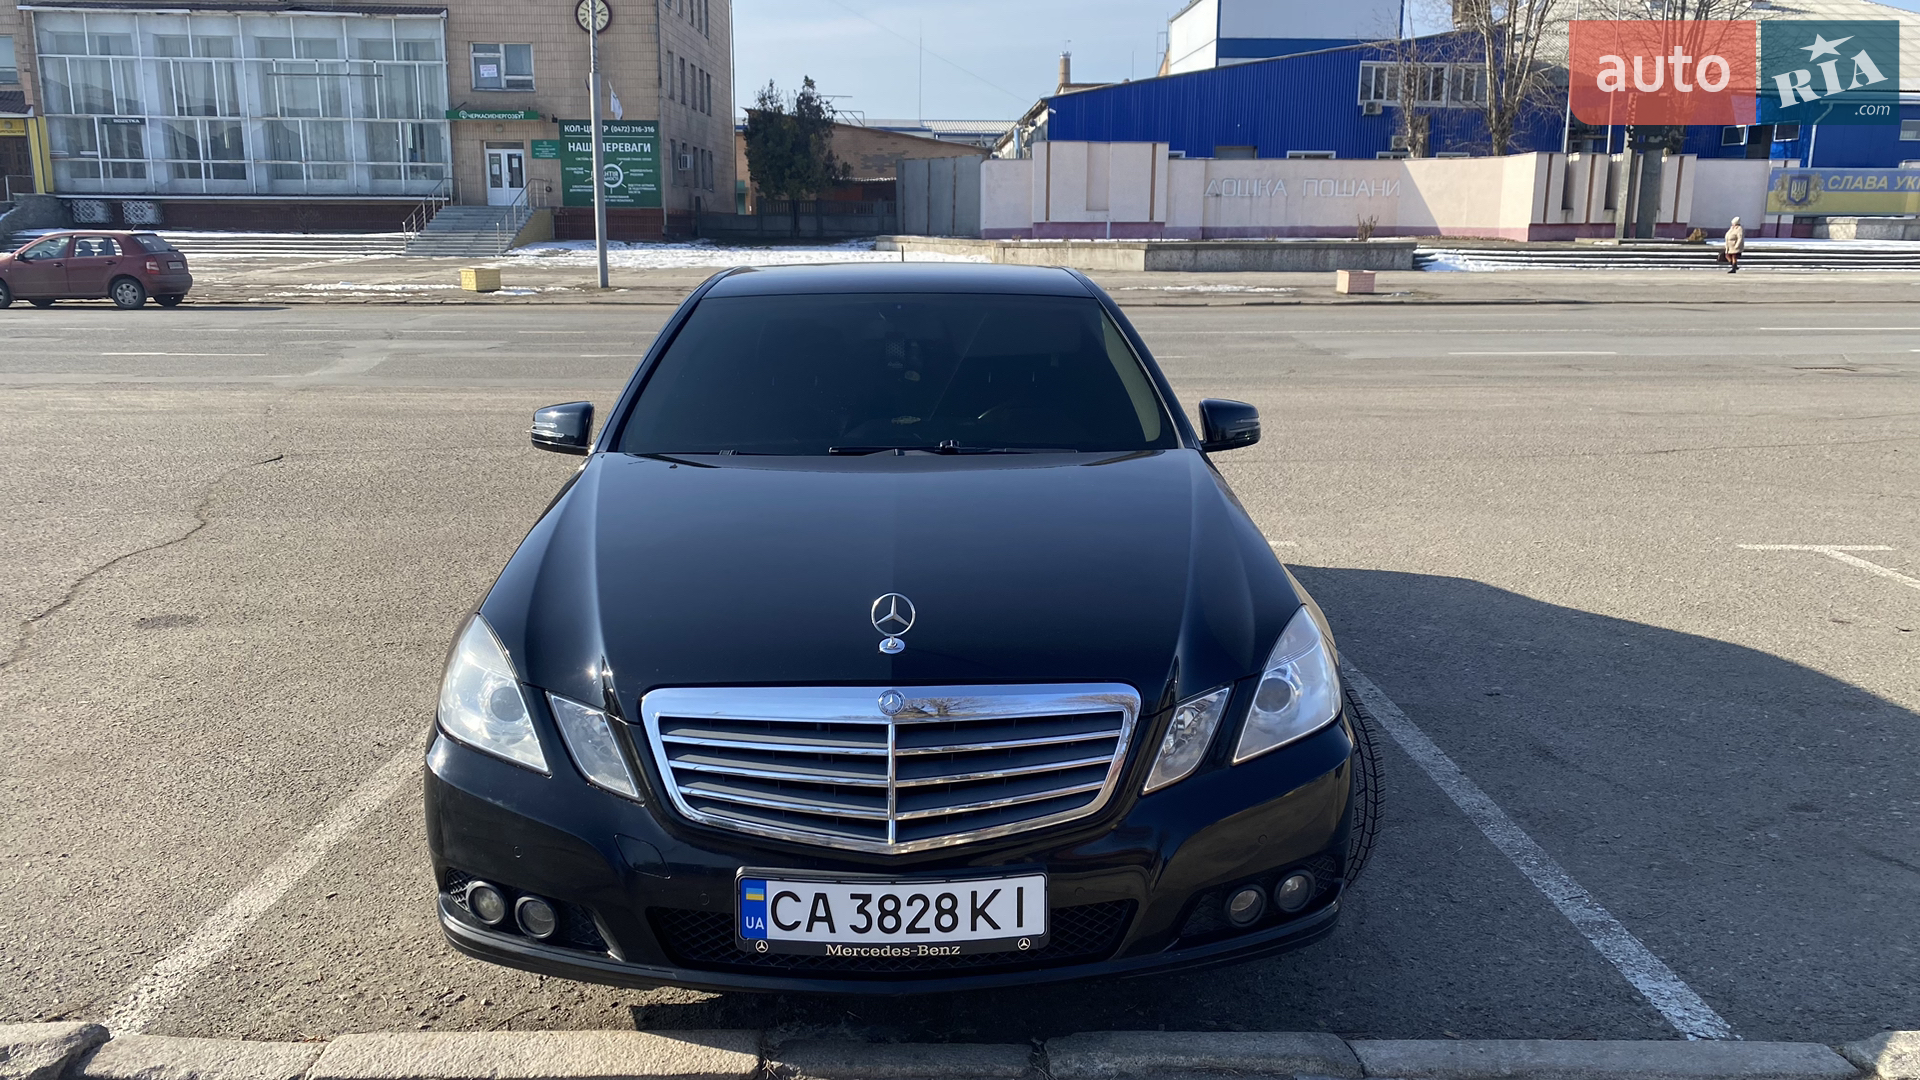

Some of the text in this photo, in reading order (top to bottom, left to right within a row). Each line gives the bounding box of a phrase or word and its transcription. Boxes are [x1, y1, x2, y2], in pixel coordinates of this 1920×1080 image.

[1204, 178, 1400, 198] ДОШКА ПОШАНИ
[1827, 175, 1888, 190] СЛАВА
[770, 890, 837, 934] CA
[849, 892, 959, 934] 3828
[746, 916, 764, 930] UA
[825, 944, 961, 957] Mercedes-Benz
